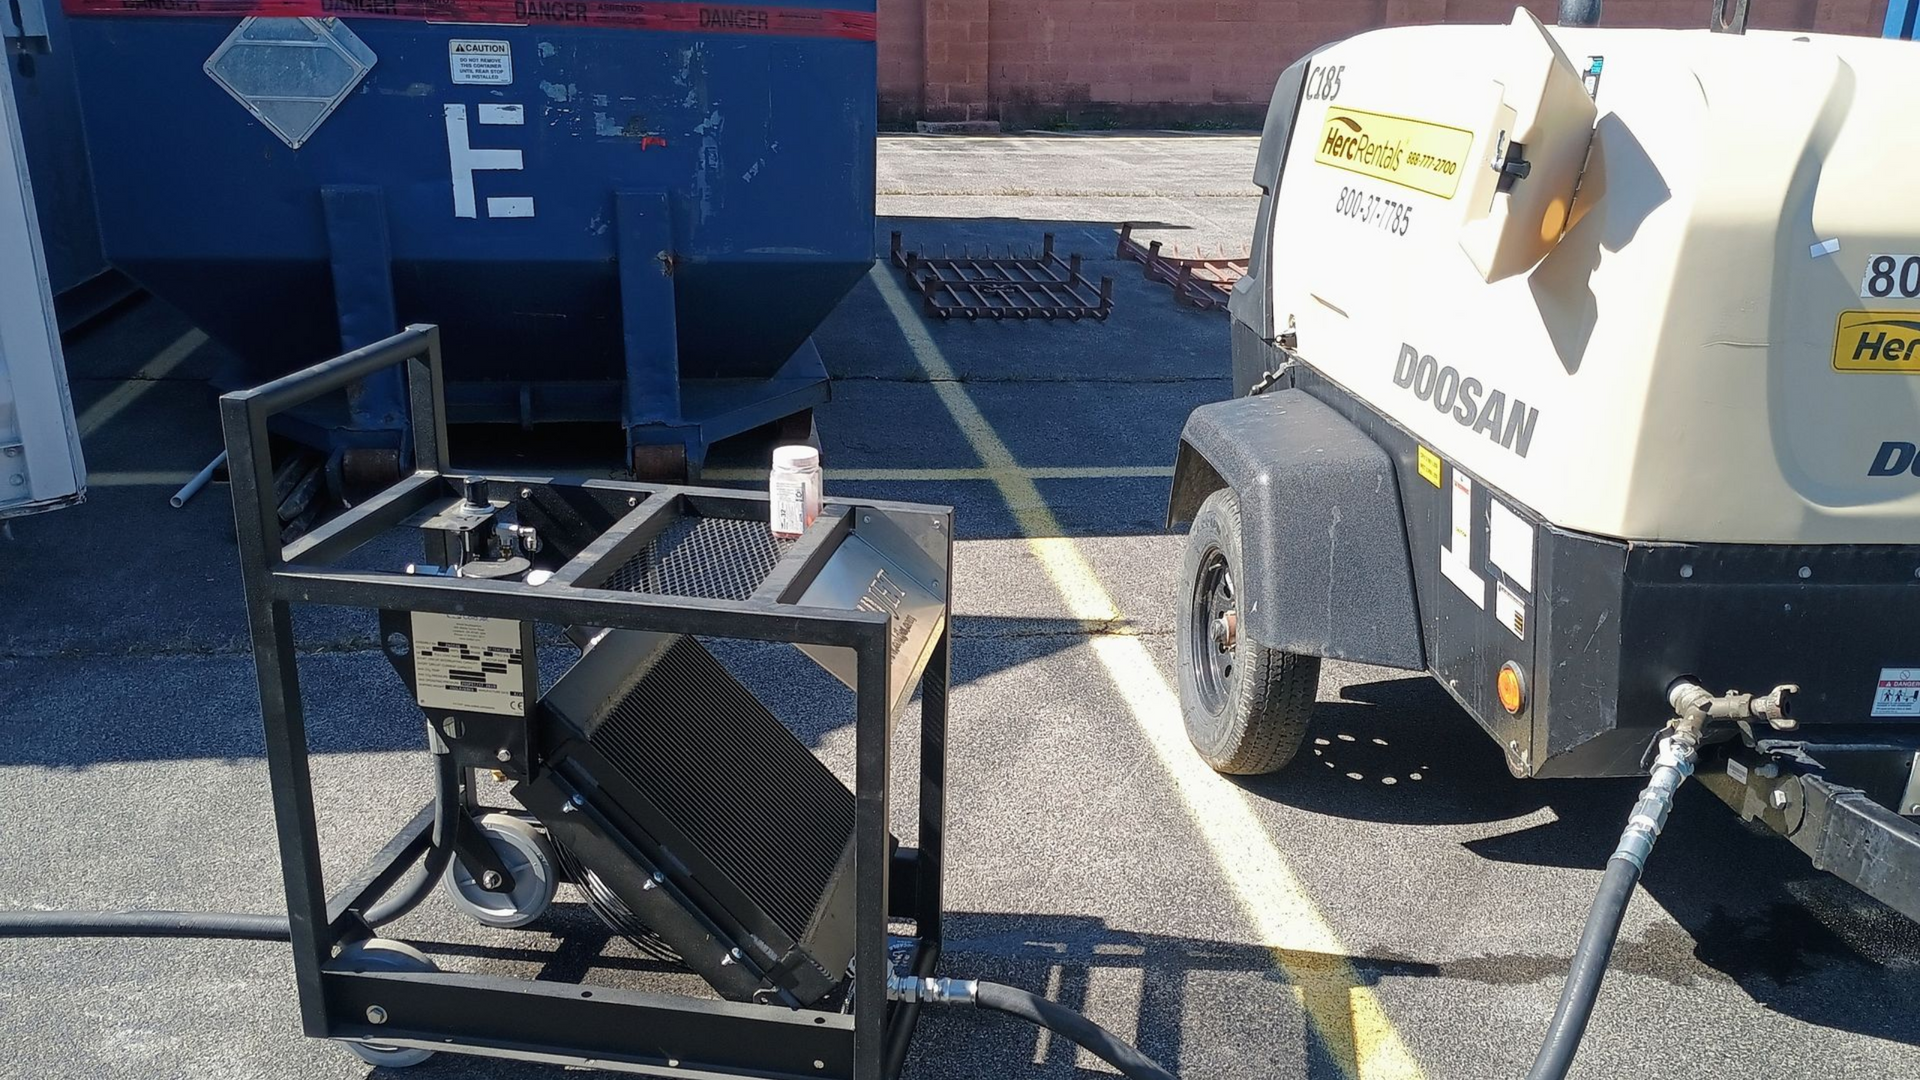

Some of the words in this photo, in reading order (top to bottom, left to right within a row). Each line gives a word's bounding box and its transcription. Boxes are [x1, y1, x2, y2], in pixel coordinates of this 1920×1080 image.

[515, 1, 587, 21] DANGER
[700, 8, 768, 29] DANGER
[465, 44, 505, 53] CAUTION
[1306, 65, 1345, 101] C185
[1335, 186, 1413, 237] 800-37-7785
[1392, 342, 1540, 459] DOOSAN
[1867, 441, 1920, 477] D
